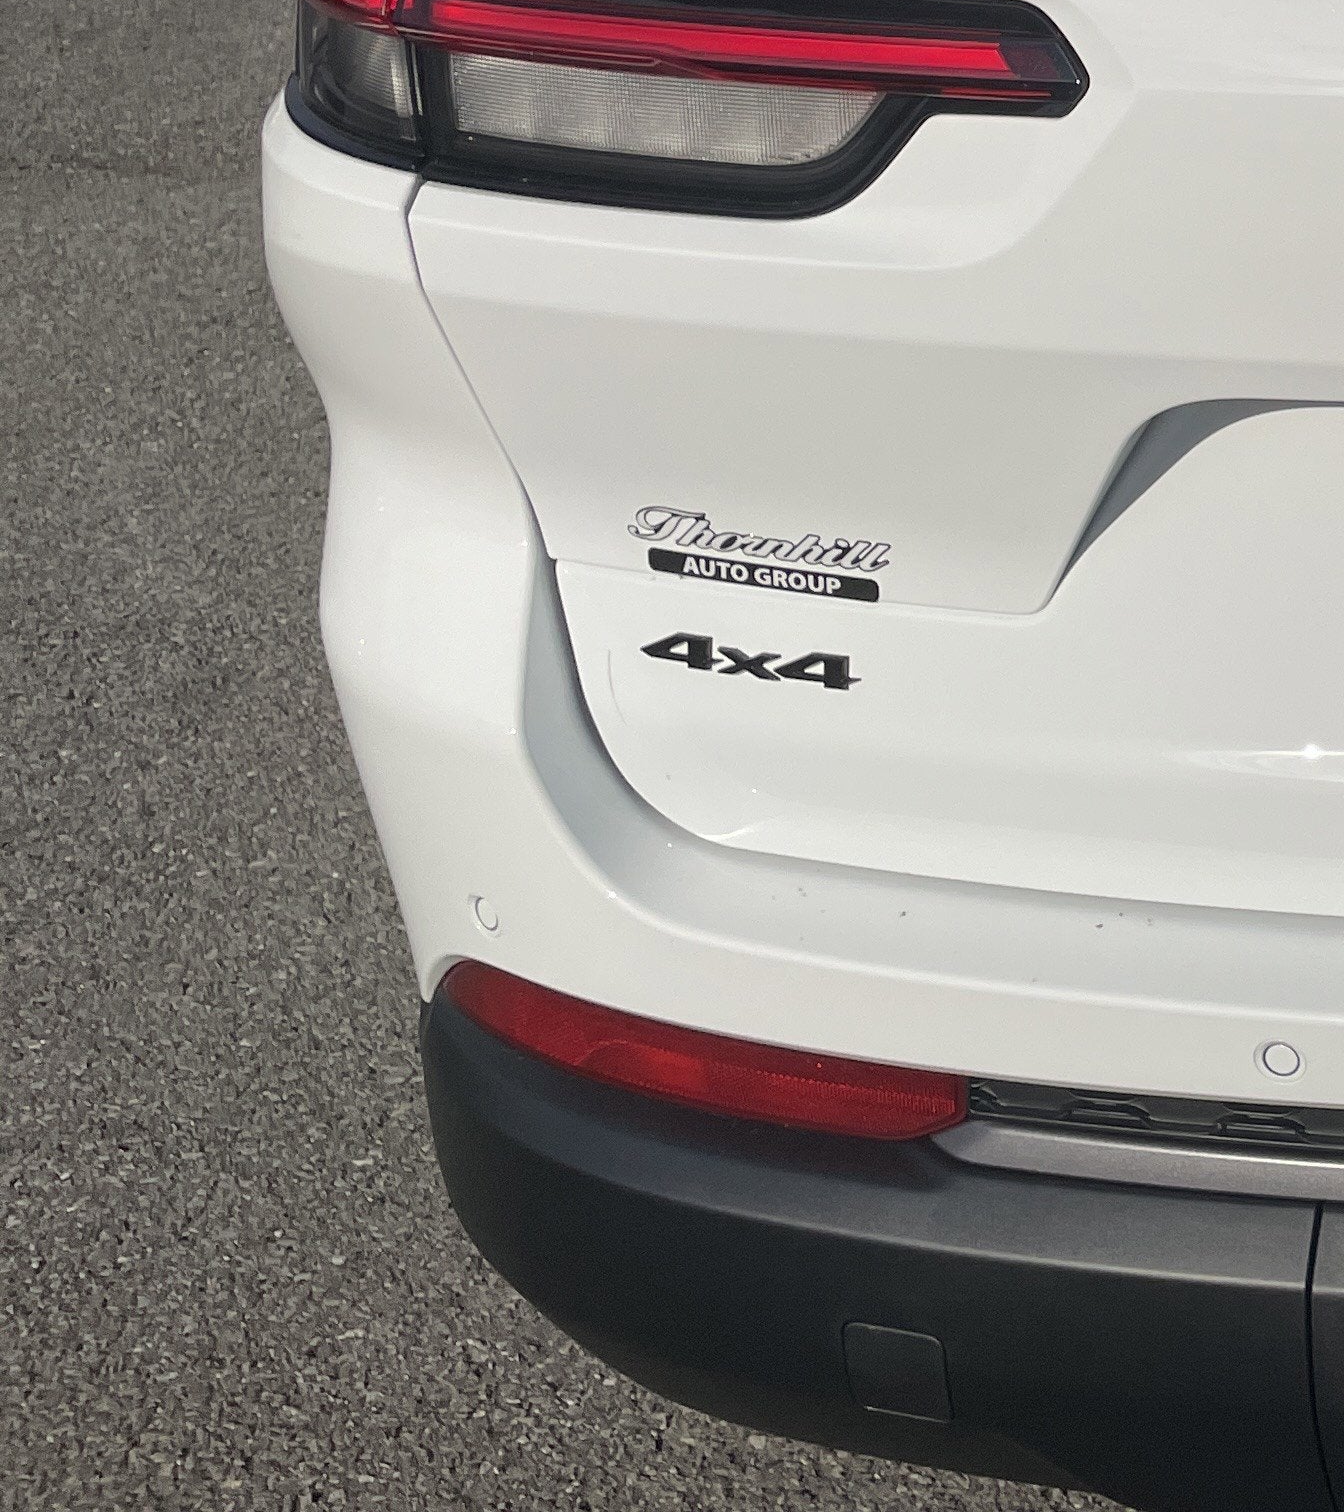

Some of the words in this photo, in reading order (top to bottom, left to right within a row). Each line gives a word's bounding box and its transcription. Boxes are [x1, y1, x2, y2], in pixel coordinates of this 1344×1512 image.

[626, 504, 892, 572] Thornhill
[682, 556, 749, 583] AUTO
[752, 566, 842, 594] GROUP
[639, 631, 862, 691] 4x4
